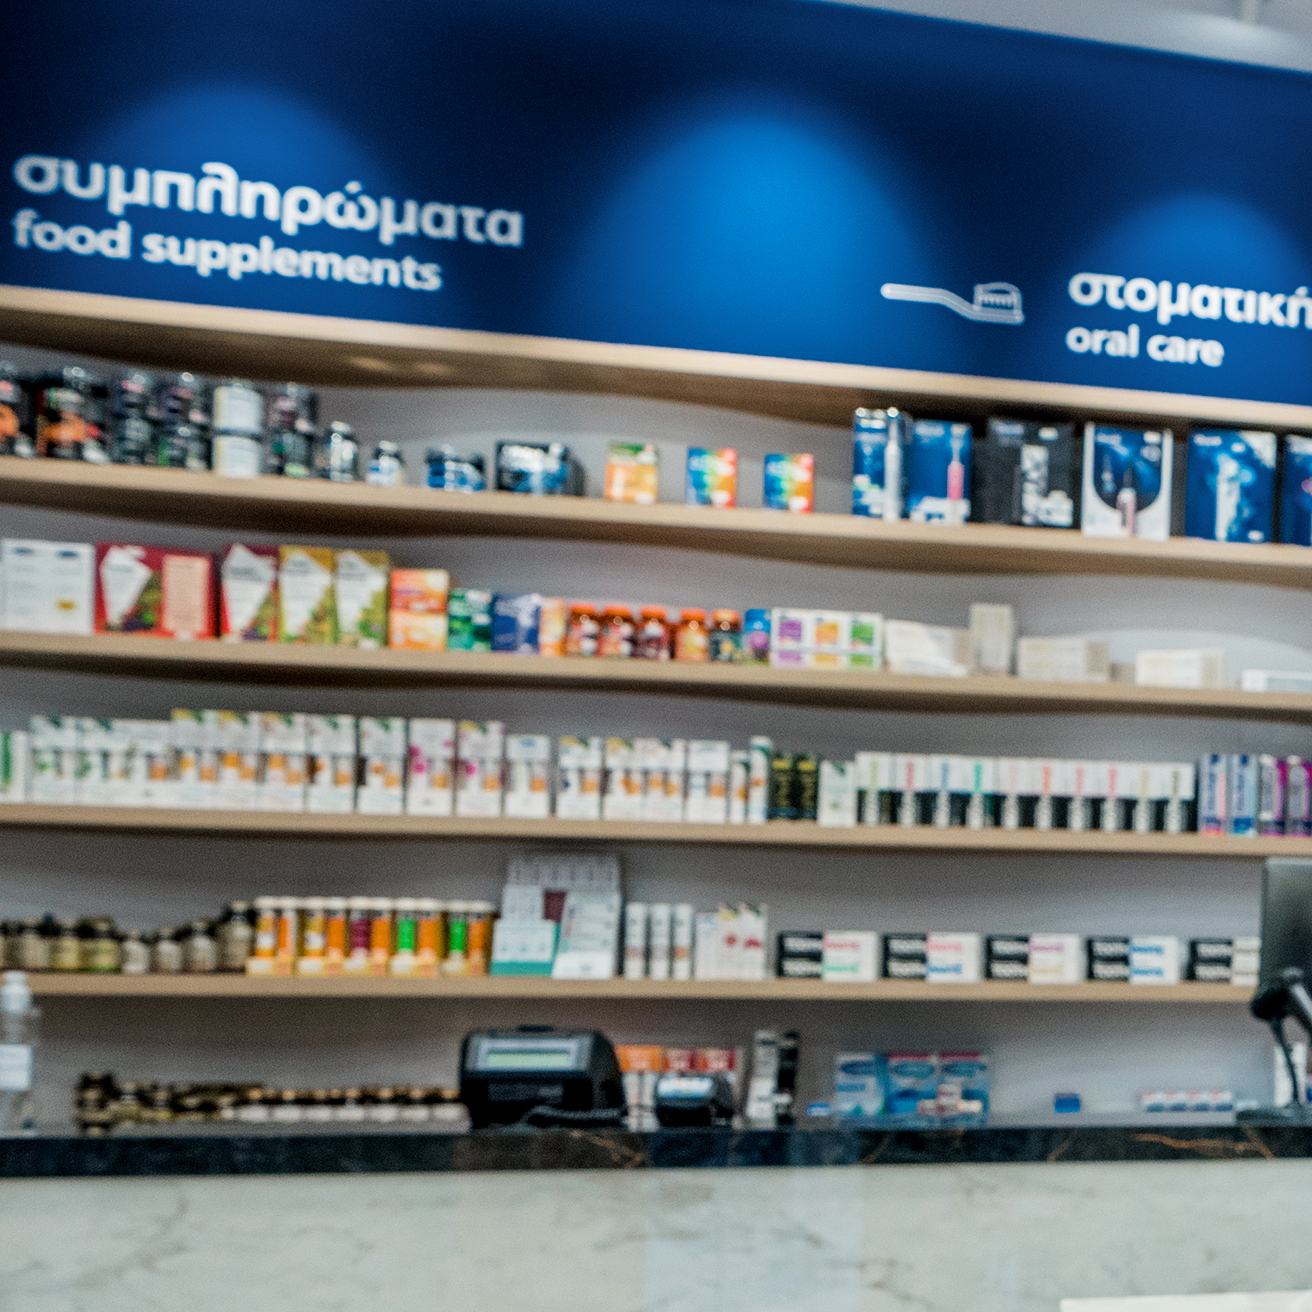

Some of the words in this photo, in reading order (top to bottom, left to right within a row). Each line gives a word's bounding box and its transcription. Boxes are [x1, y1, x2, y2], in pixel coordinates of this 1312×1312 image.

[12, 153, 525, 249] συμπληρώματα
[12, 207, 133, 261] food
[141, 232, 443, 293] supplements
[1065, 324, 1140, 360] oral
[1146, 334, 1225, 369] care
